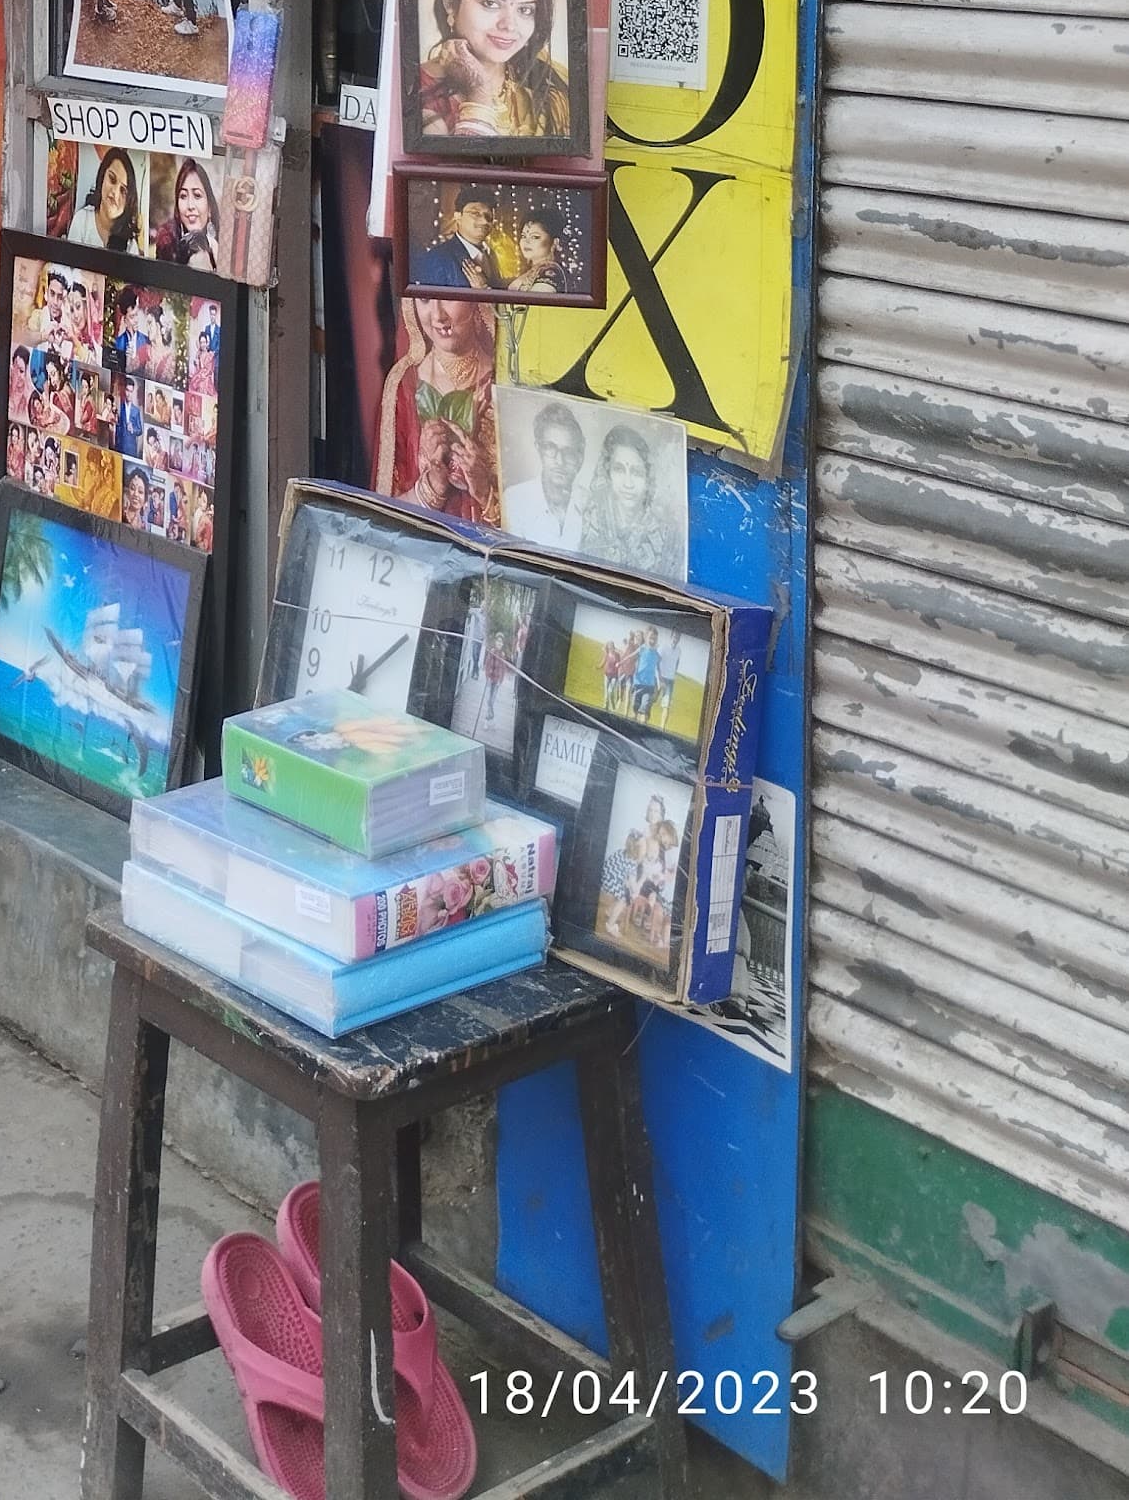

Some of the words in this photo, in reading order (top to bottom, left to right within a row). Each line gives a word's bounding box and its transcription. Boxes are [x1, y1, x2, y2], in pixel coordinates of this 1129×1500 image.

[343, 94, 377, 125] DA
[53, 102, 119, 141] SHOP
[129, 110, 206, 151] OPEN
[328, 546, 346, 571] 11
[368, 550, 395, 587] 12
[311, 605, 332, 634] 10
[306, 647, 320, 678] 9
[376, 912, 387, 949] PHOTOS
